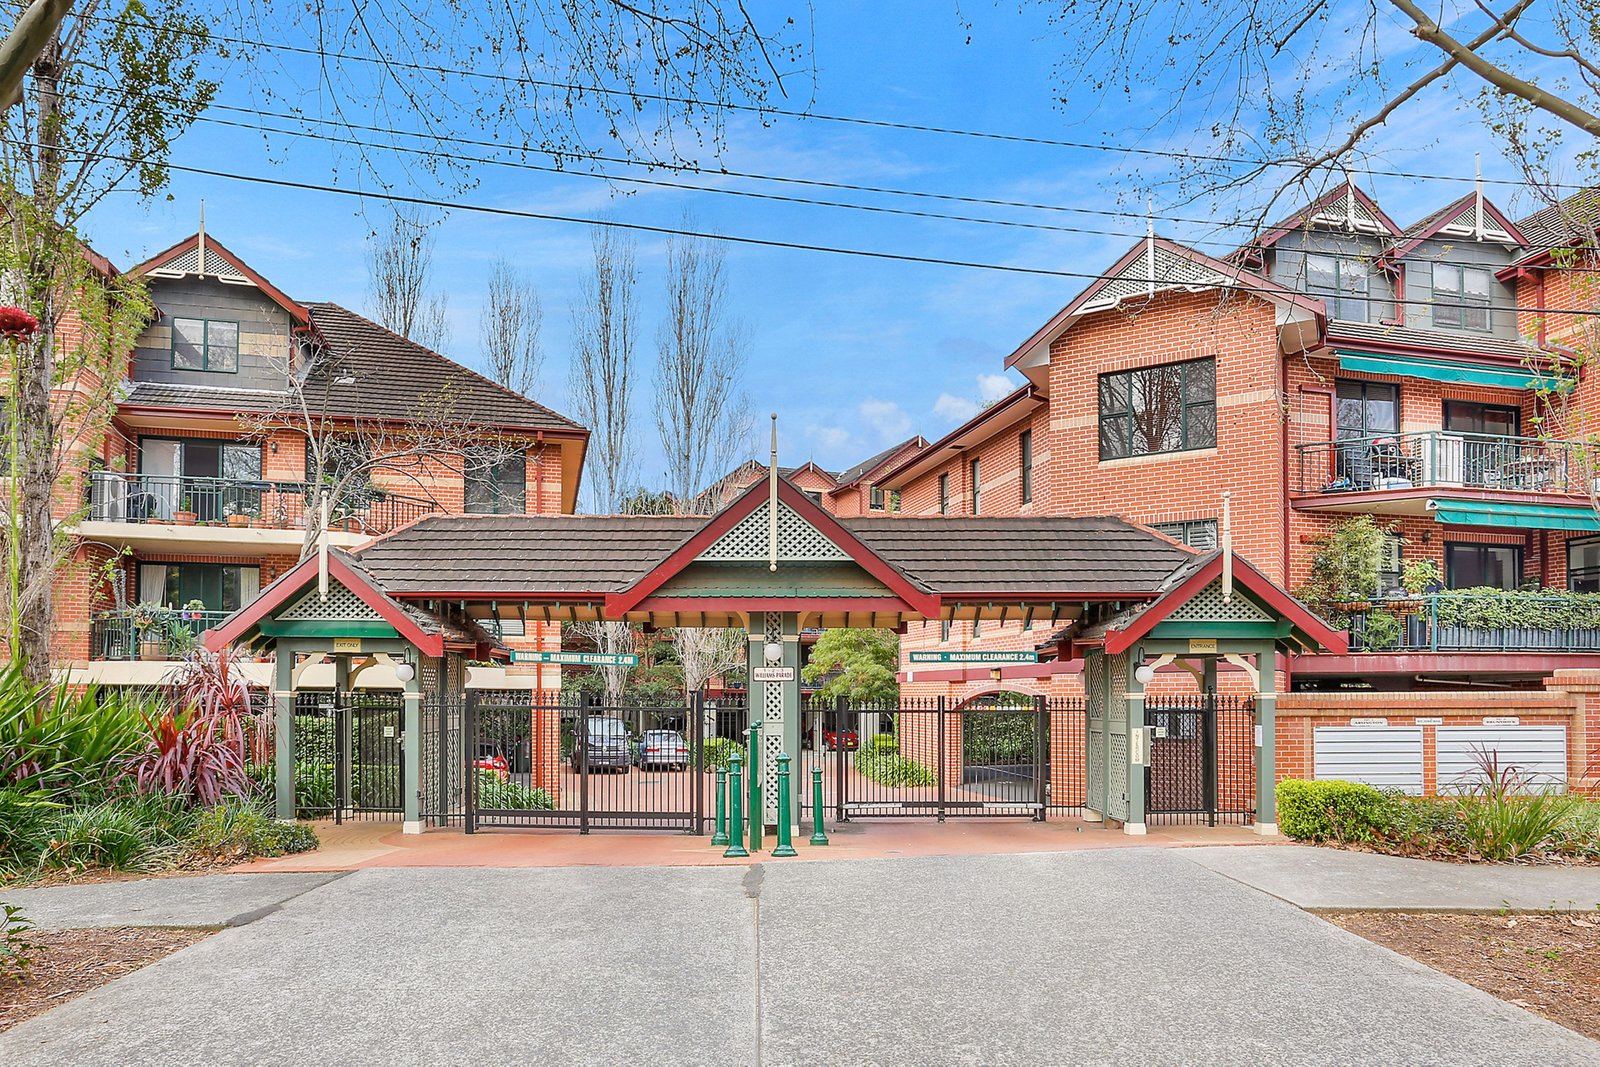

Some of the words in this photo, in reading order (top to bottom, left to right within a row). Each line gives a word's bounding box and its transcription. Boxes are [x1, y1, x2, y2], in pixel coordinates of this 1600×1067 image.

[514, 653, 542, 661] WARNING
[550, 654, 580, 662] MAXIMUM
[583, 655, 616, 664] CLEARANCE
[618, 656, 634, 664] 2.4M
